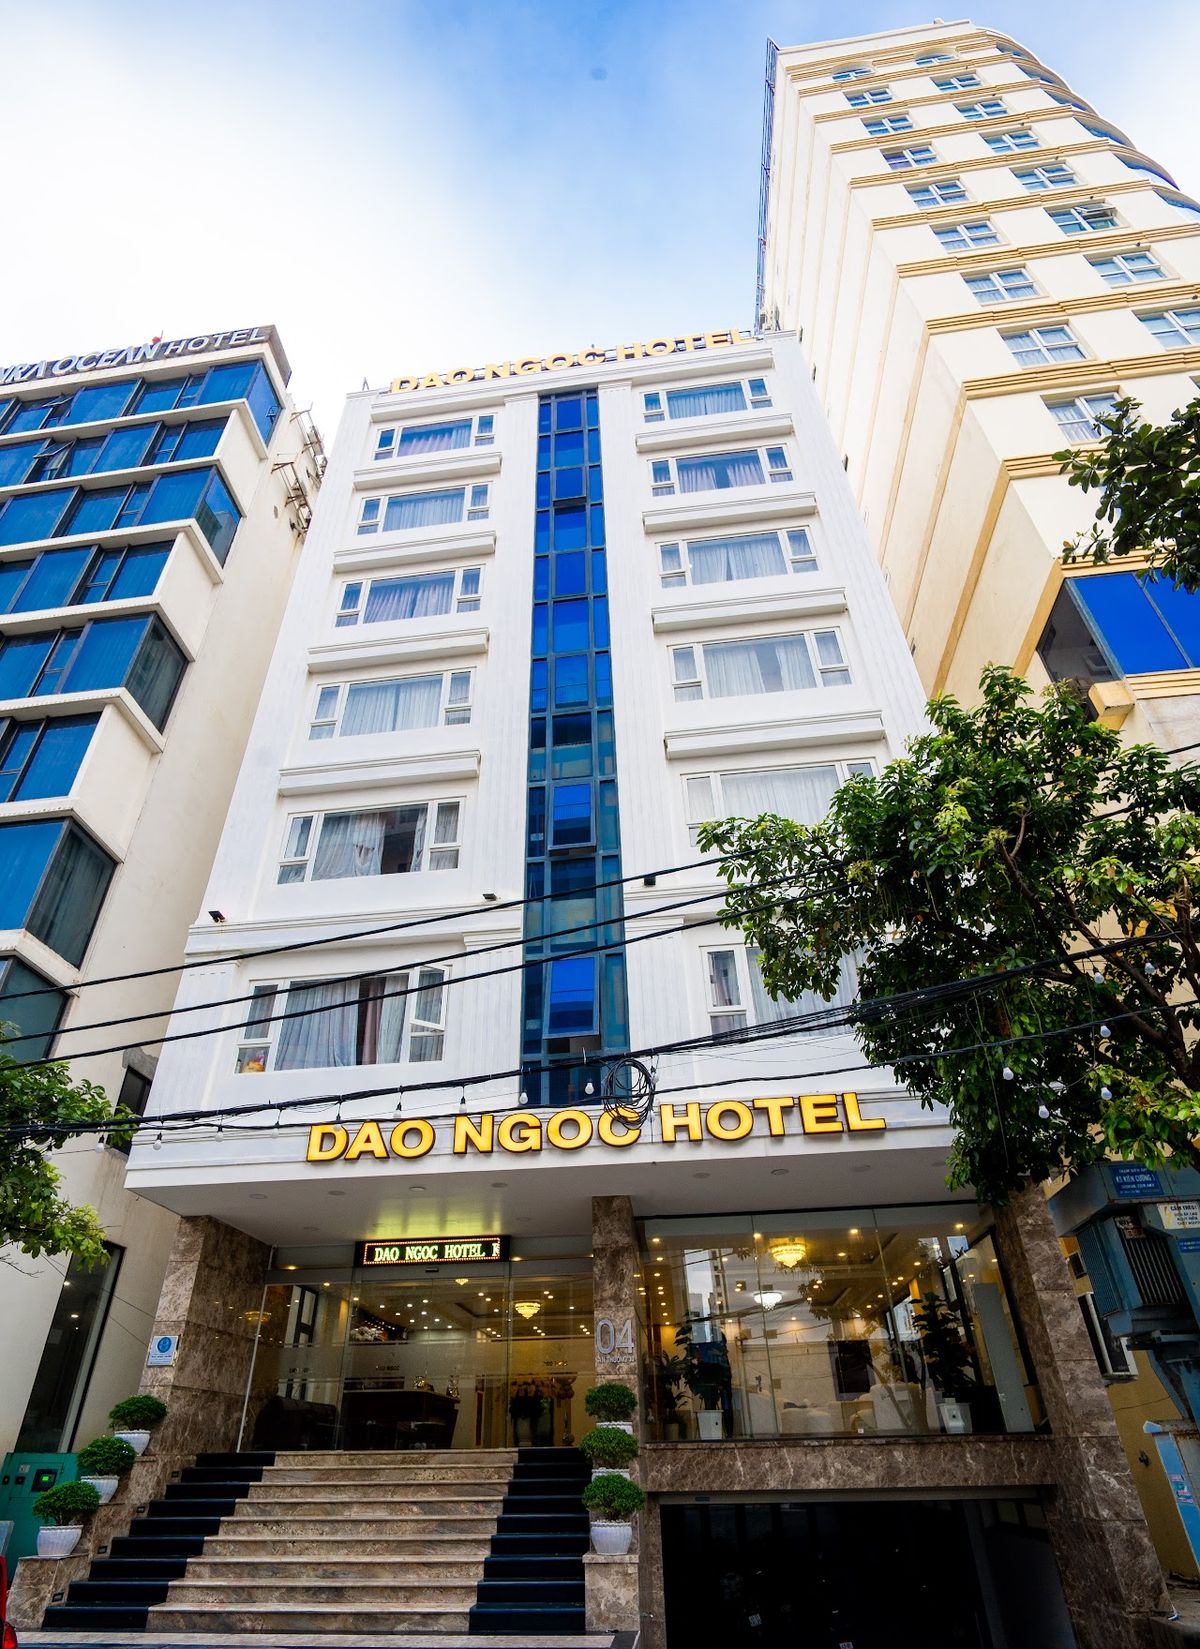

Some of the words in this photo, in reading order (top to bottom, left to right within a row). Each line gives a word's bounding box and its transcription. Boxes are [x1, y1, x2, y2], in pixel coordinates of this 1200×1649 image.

[52, 343, 161, 375] OCEAN
[164, 328, 266, 355] HOTEL
[390, 367, 474, 393] DAO
[484, 347, 606, 380] NGOC
[616, 328, 755, 361] HOTEL
[306, 1119, 435, 1162] DAO
[453, 1107, 641, 1154] NGOC
[661, 1091, 886, 1143] HOTEL
[374, 1247, 399, 1262] DAO
[405, 1245, 439, 1260] NGOC
[444, 1243, 486, 1259] HOTEL
[596, 1317, 635, 1354] 04
